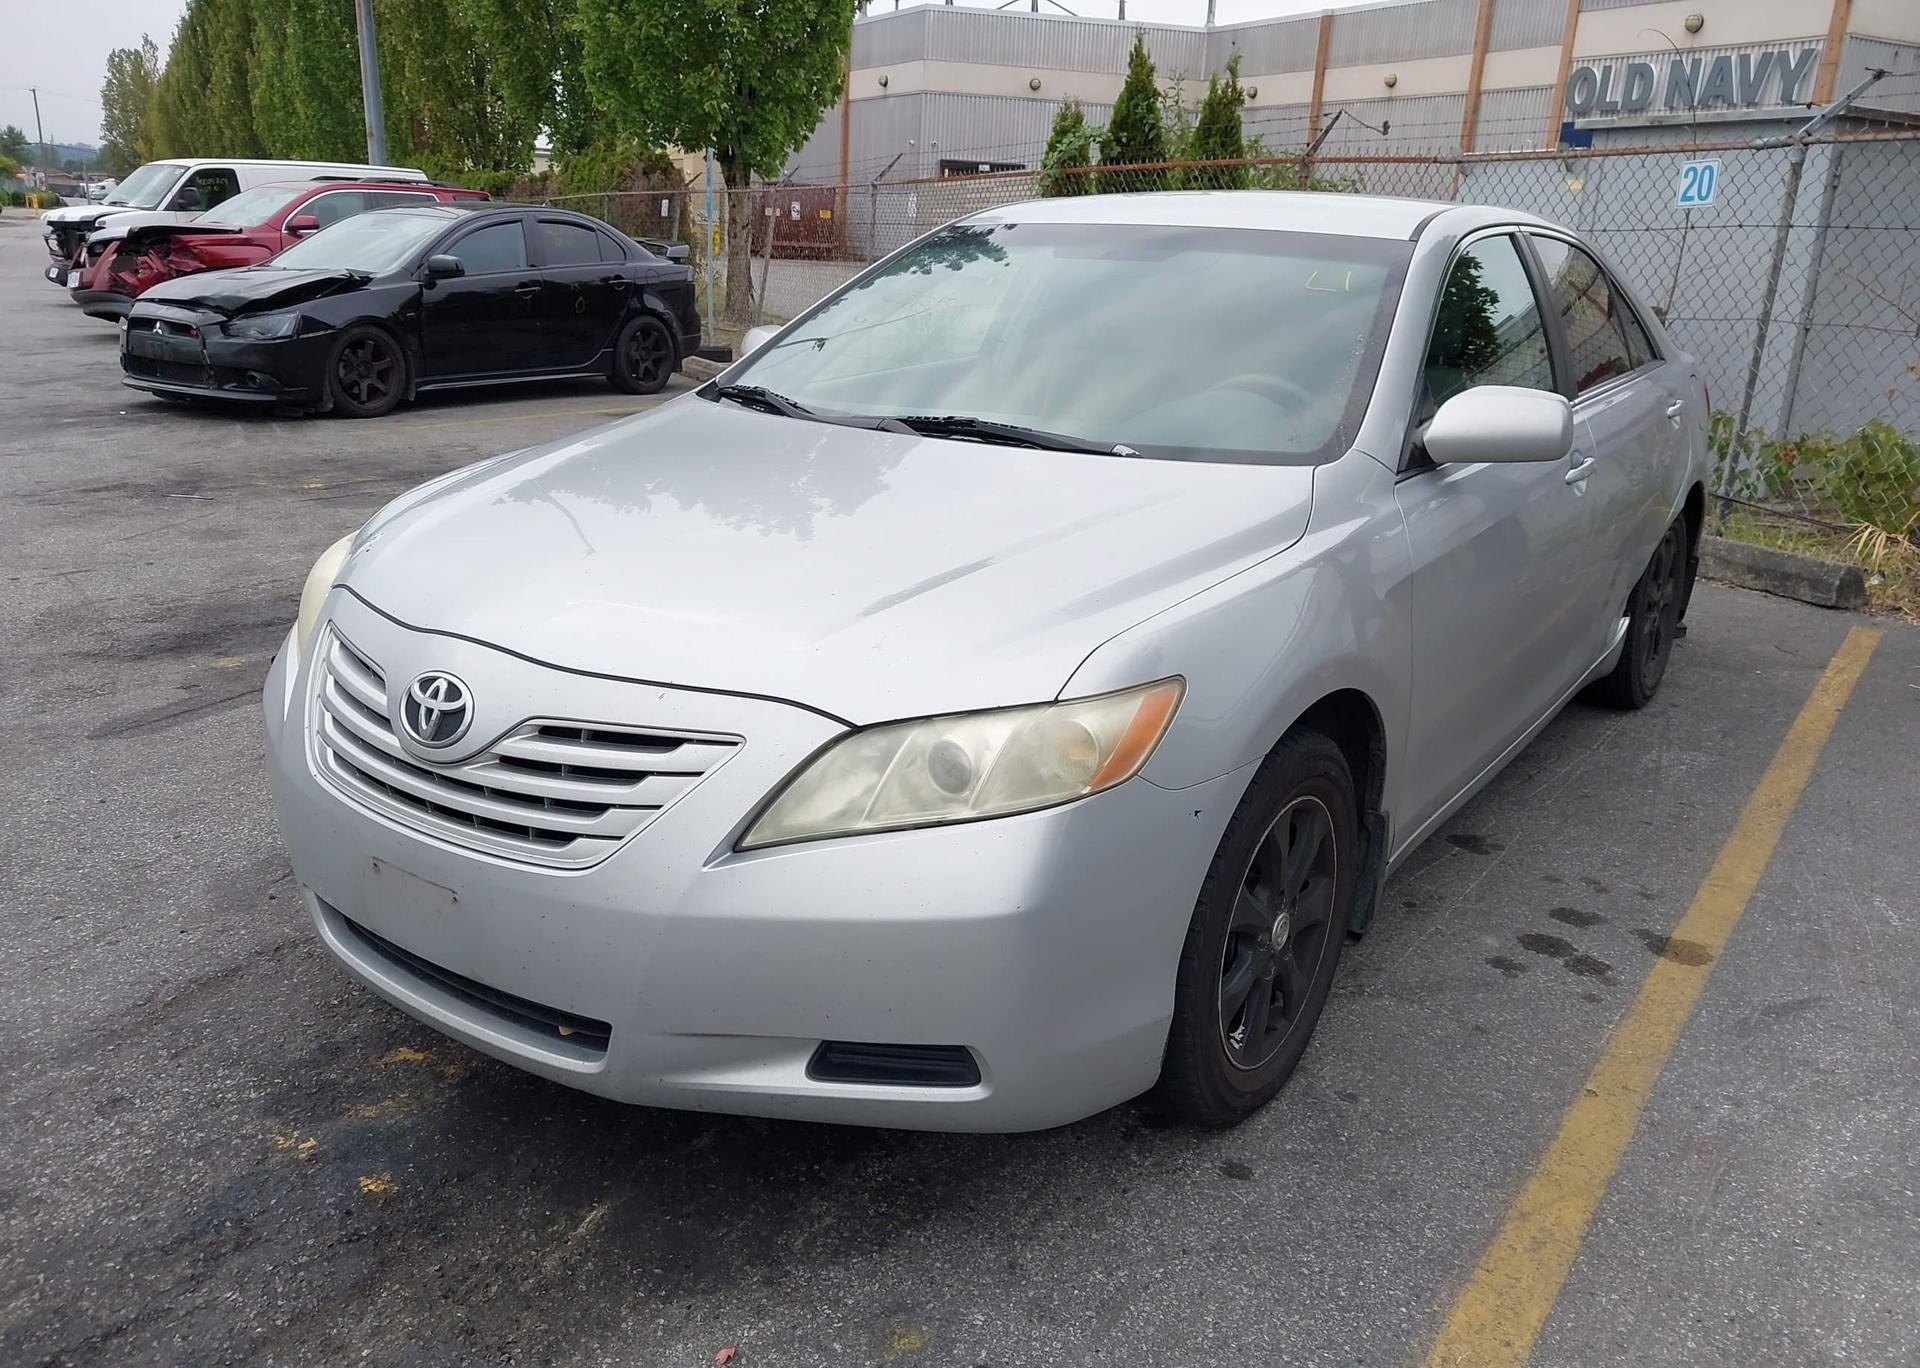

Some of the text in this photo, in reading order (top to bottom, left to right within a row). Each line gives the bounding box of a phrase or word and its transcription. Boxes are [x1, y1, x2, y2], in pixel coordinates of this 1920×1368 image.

[1566, 48, 1818, 113] OLD NAVY
[1680, 165, 1715, 202] 20
